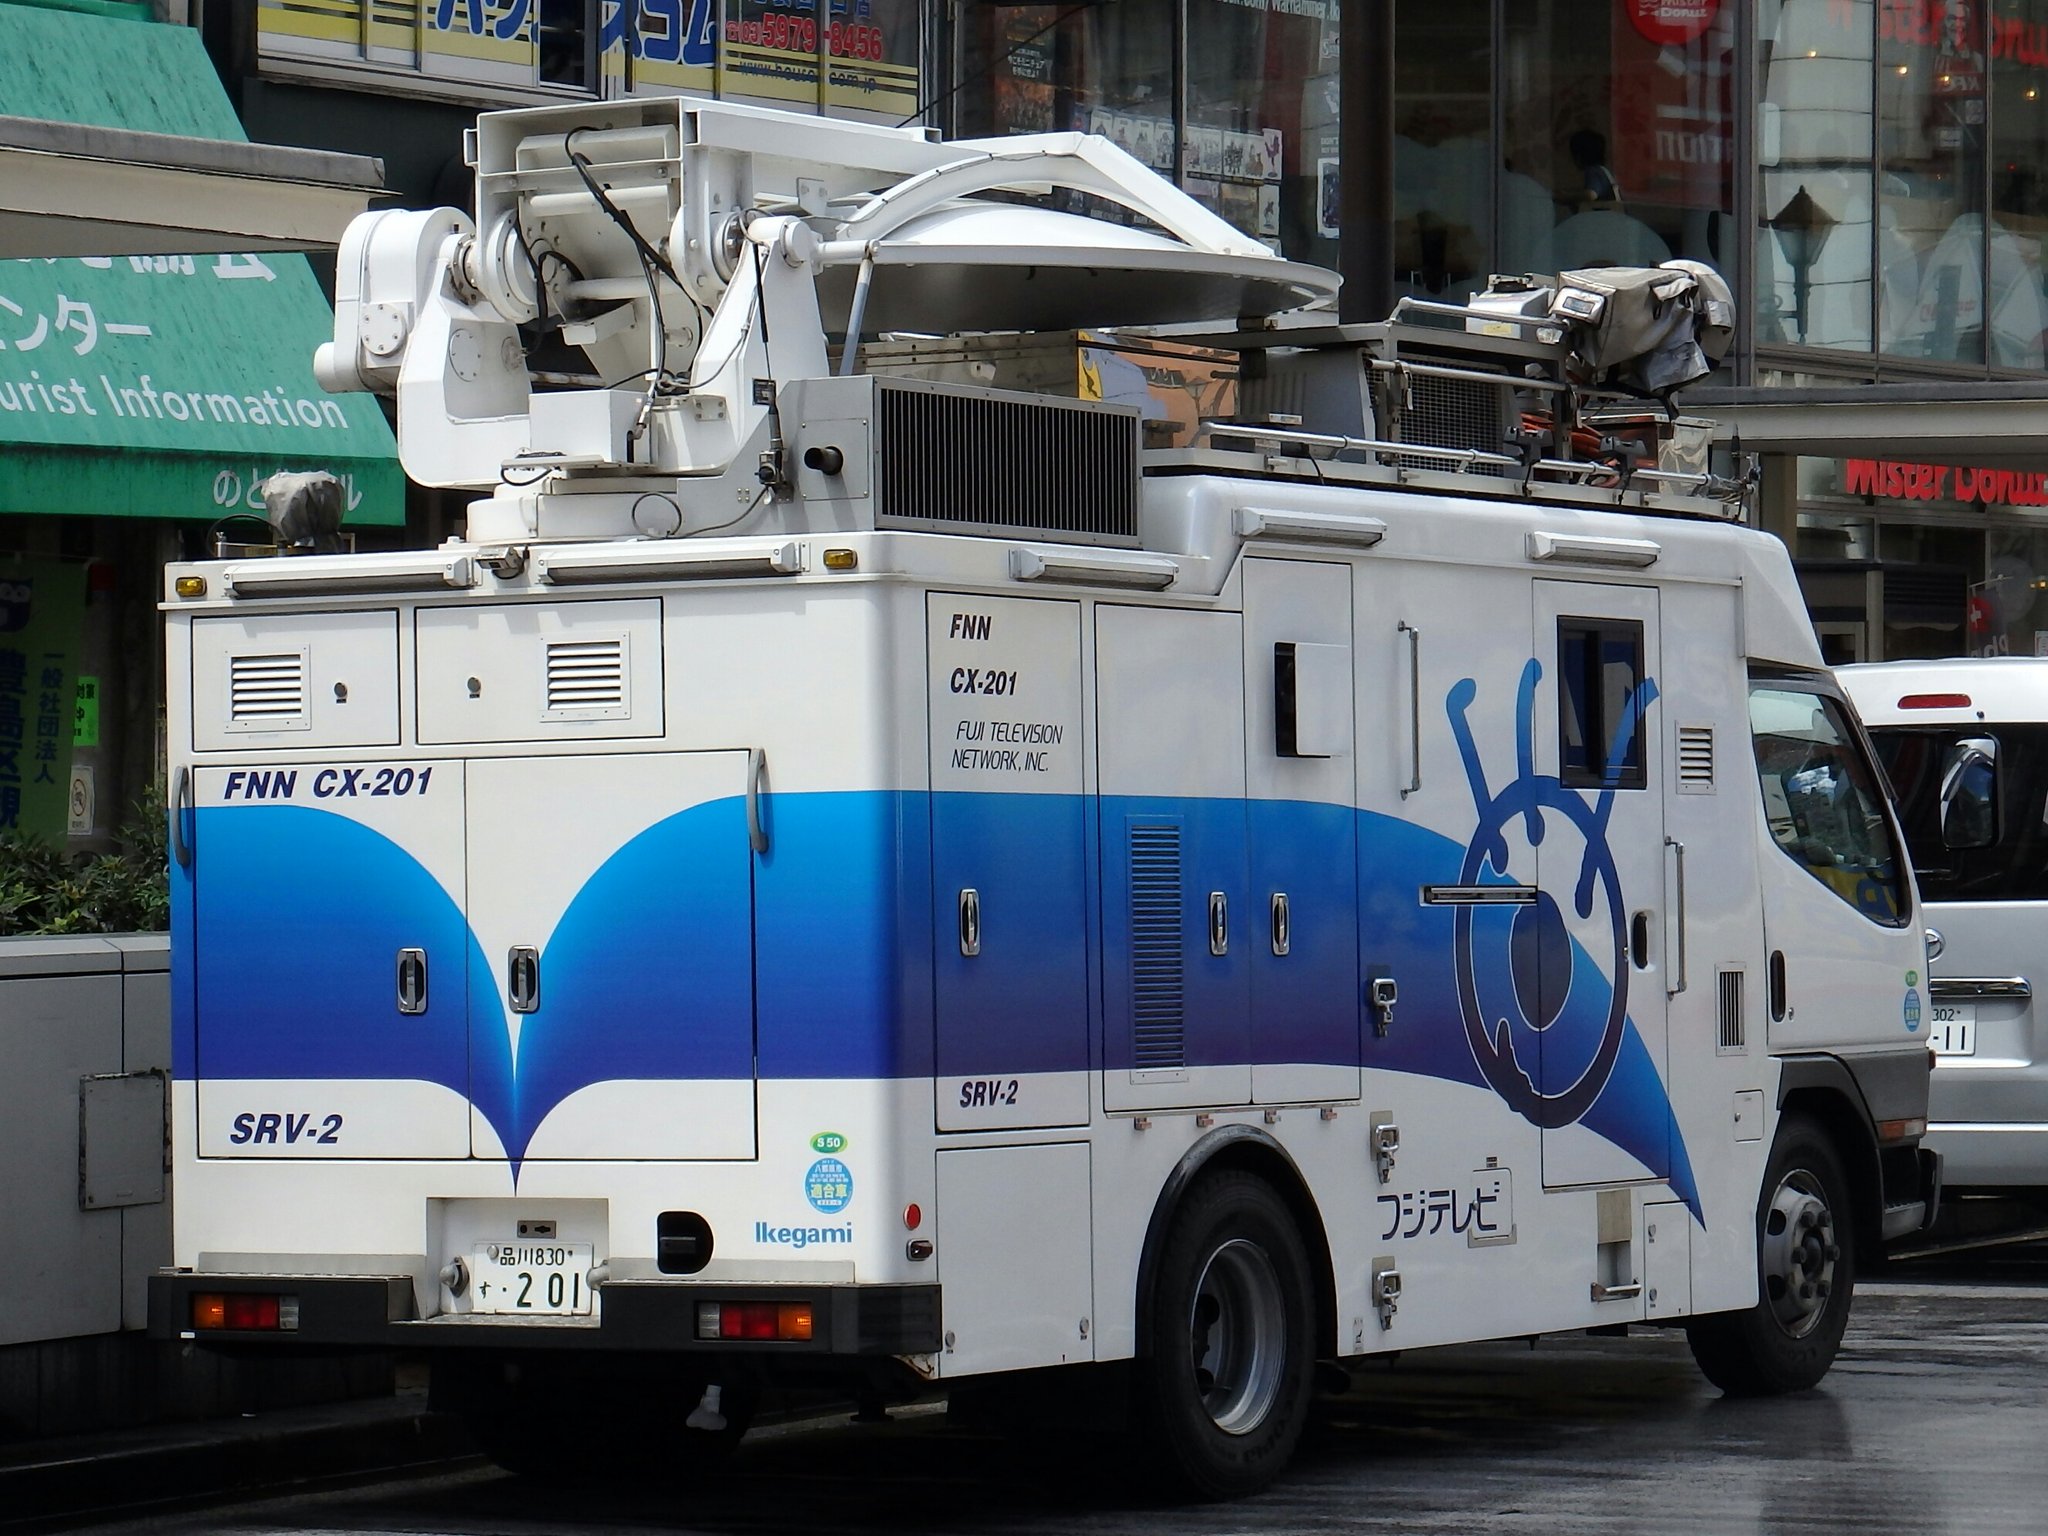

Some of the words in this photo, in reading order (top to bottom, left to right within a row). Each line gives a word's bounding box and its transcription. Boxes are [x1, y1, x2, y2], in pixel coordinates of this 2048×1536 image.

[1660, 7, 1707, 17] Donut
[100, 374, 349, 429] Information
[1846, 458, 1949, 500] Mister
[950, 614, 991, 641] FNN
[950, 667, 1017, 696] CX-201
[956, 720, 985, 741] FUJI
[991, 721, 1063, 745] TELEVISION
[952, 748, 1022, 773] NETWORK,
[1024, 751, 1049, 772] INC.
[224, 770, 297, 799] FNN
[313, 767, 432, 798] CX-201
[1932, 1008, 1954, 1022] 302
[960, 1080, 1018, 1108] SRV-2
[230, 1113, 343, 1144] SRV-2
[1377, 1181, 1500, 1240] フジテレビ
[755, 1222, 852, 1249] Ikegami
[479, 1281, 492, 1299] す
